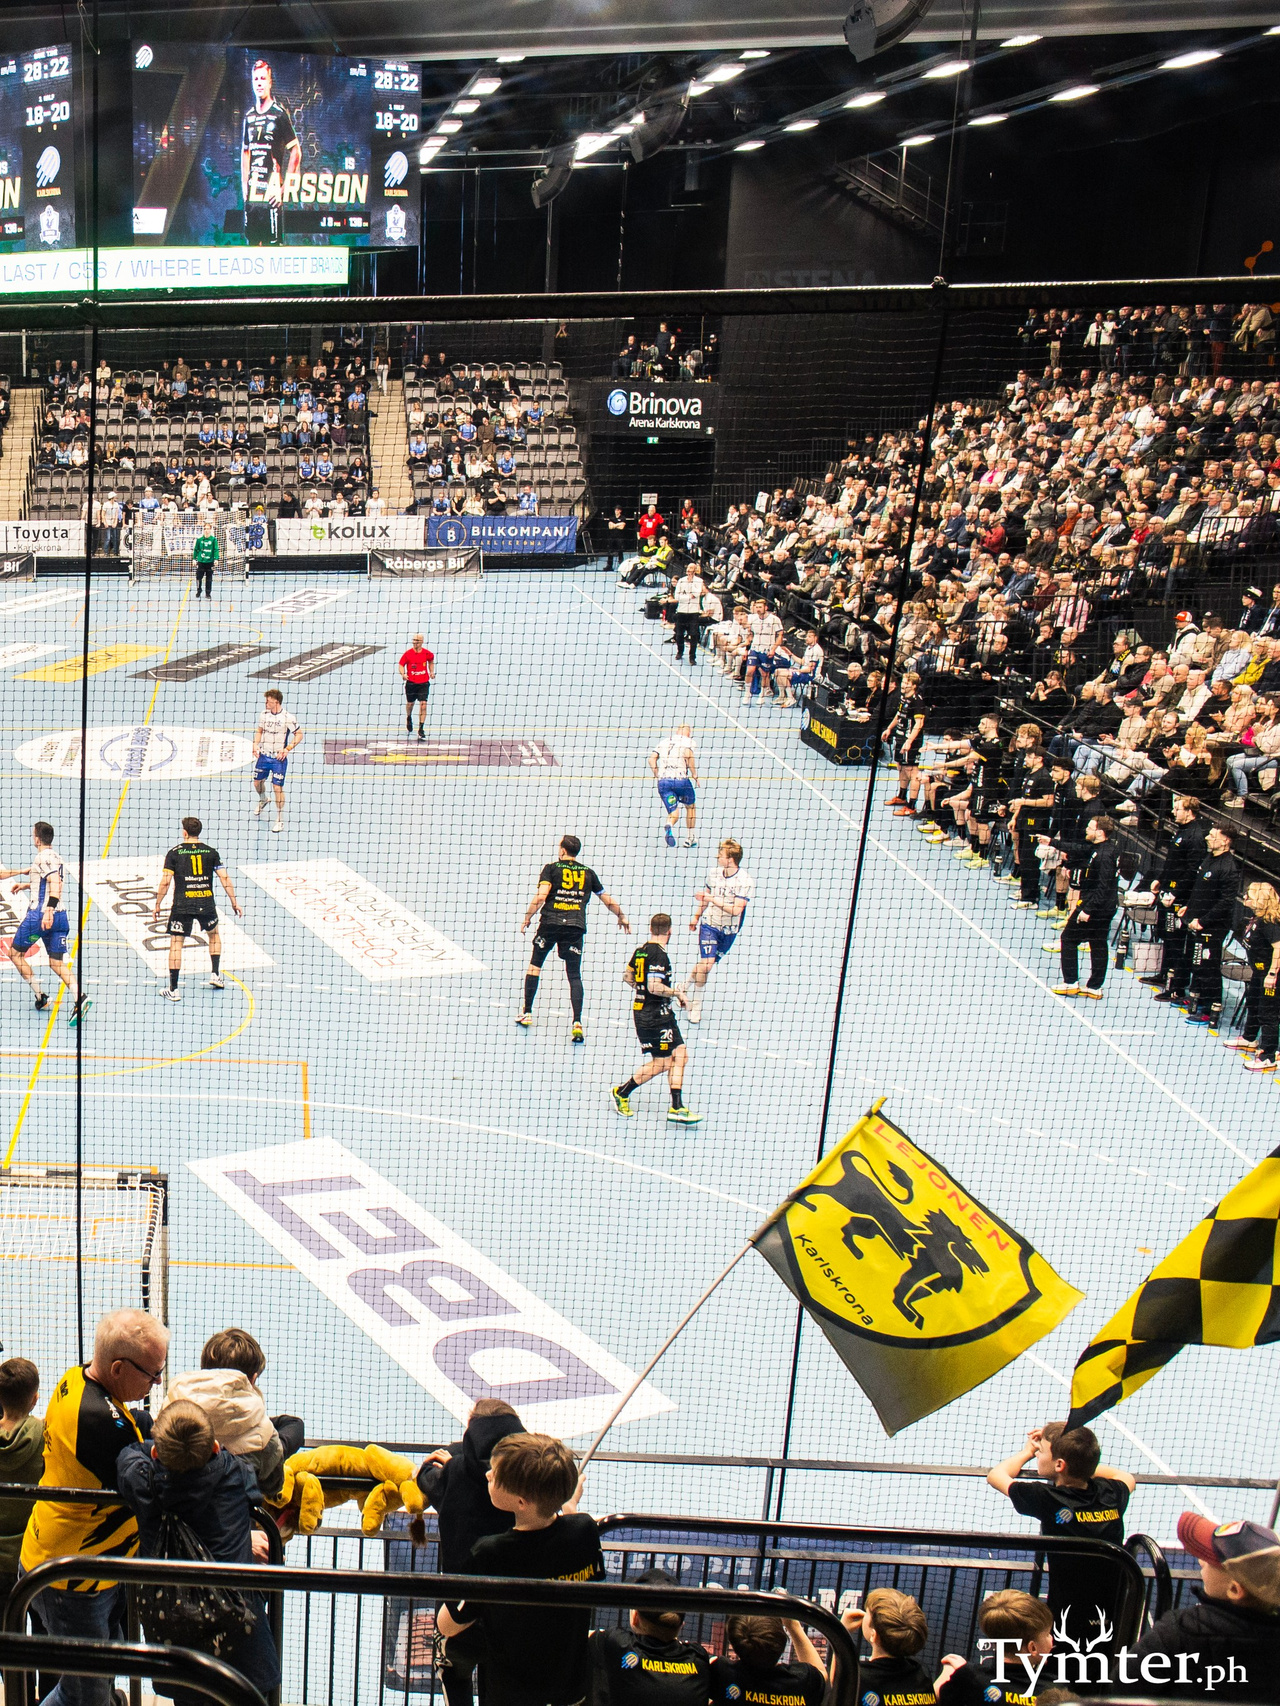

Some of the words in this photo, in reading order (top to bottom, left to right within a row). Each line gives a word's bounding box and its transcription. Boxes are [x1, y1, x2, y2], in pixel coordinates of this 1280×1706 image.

[23, 56, 69, 83] 28:22
[374, 71, 419, 92] 28:22
[26, 101, 69, 126] 18-20
[375, 111, 418, 131] 18-20
[345, 157, 355, 170] IS
[249, 172, 369, 204] LARSSON
[3, 263, 47, 282] LAST
[131, 258, 201, 278] WHERE
[208, 257, 265, 275] LEADS
[270, 257, 306, 274] MEET
[630, 391, 702, 416] Brinova
[629, 417, 655, 428] Arena
[655, 417, 700, 430] Karlskrona
[13, 526, 68, 542] Toyota
[310, 521, 390, 539] ekolux
[471, 526, 570, 537] BILKOMPANI
[4, 561, 20, 573] Bil
[385, 556, 444, 571] Råbergs
[448, 557, 465, 569] Bil
[190, 854, 203, 876] 11
[275, 875, 321, 897] DIG
[561, 868, 586, 890] 94
[327, 879, 455, 963] KARLSKRONA
[304, 896, 411, 968] FÖRÄLSKA
[873, 1123, 1010, 1251] LEJONEN
[793, 1233, 874, 1326] Karlskrona
[1075, 1508, 1120, 1524] KARLSKRONA
[642, 1657, 699, 1676] KARLSKRONA
[745, 1690, 806, 1706] KARLSKRONA
[883, 1693, 937, 1706] KARLSKRONA
